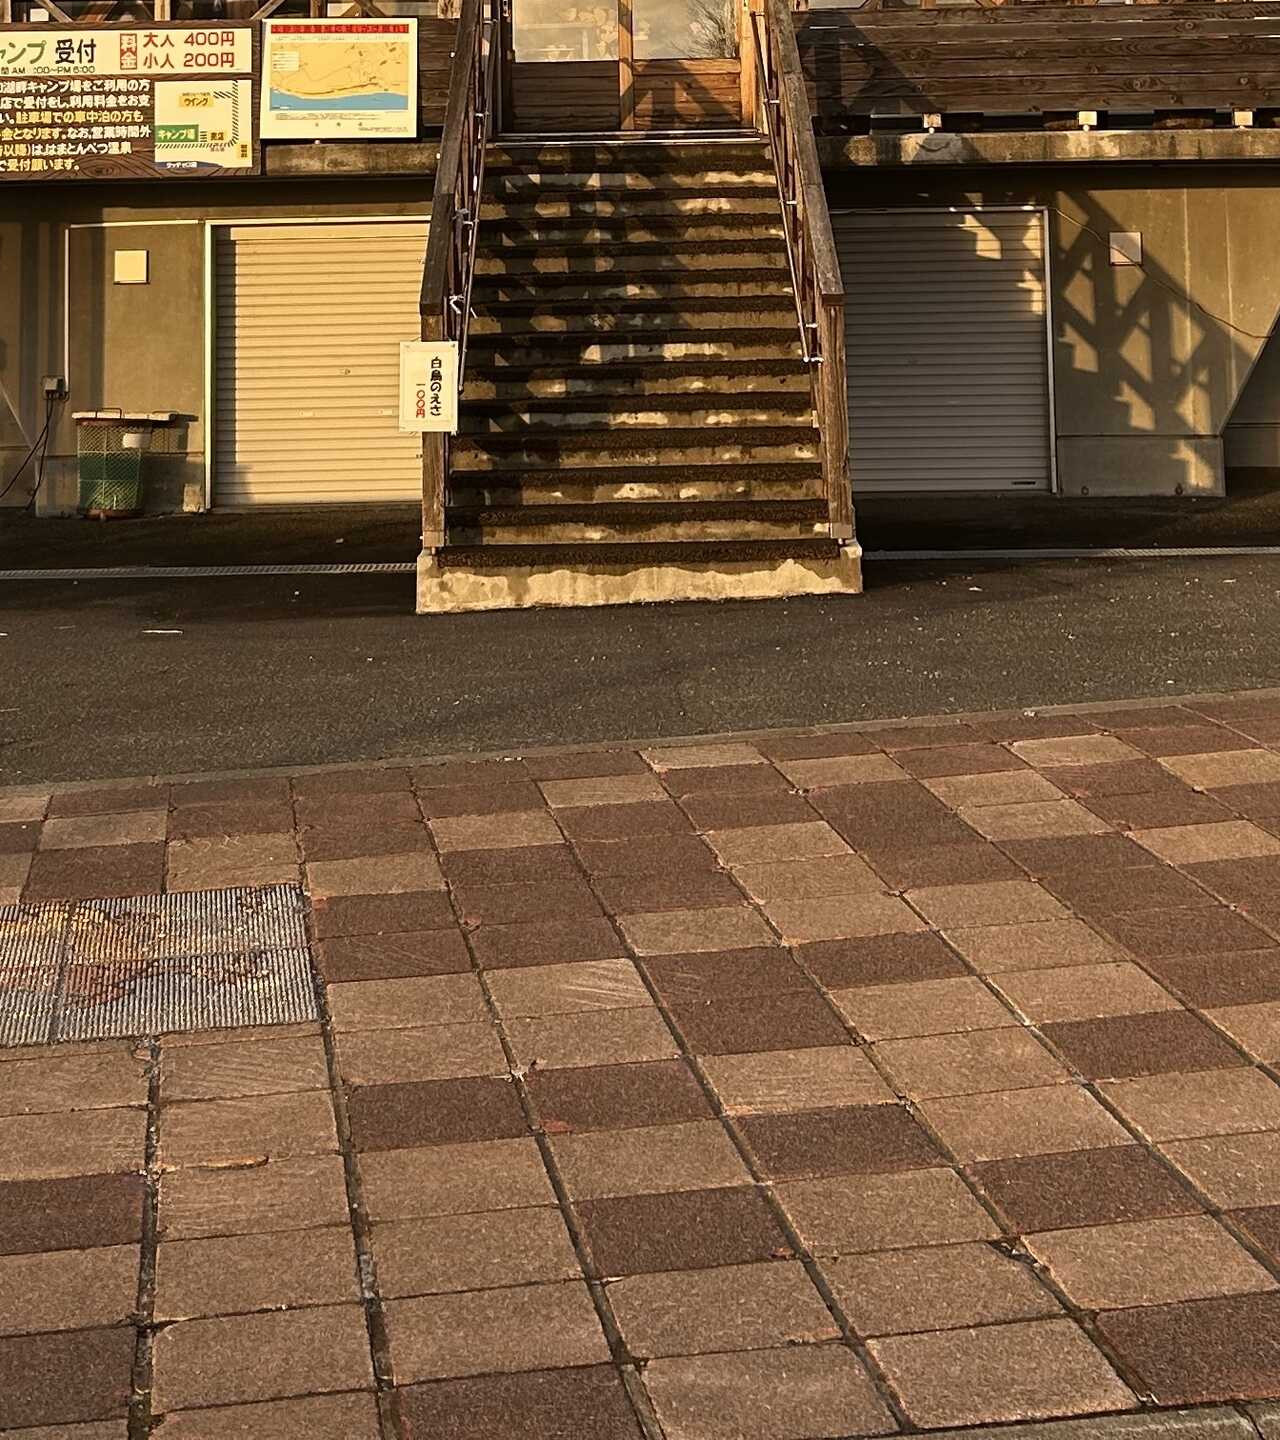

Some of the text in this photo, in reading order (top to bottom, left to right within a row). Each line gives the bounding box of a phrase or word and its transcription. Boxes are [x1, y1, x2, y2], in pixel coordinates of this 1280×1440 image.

[142, 31, 235, 48] 大人 400円
[54, 38, 97, 64] 受付
[142, 52, 235, 69] 小人 200円
